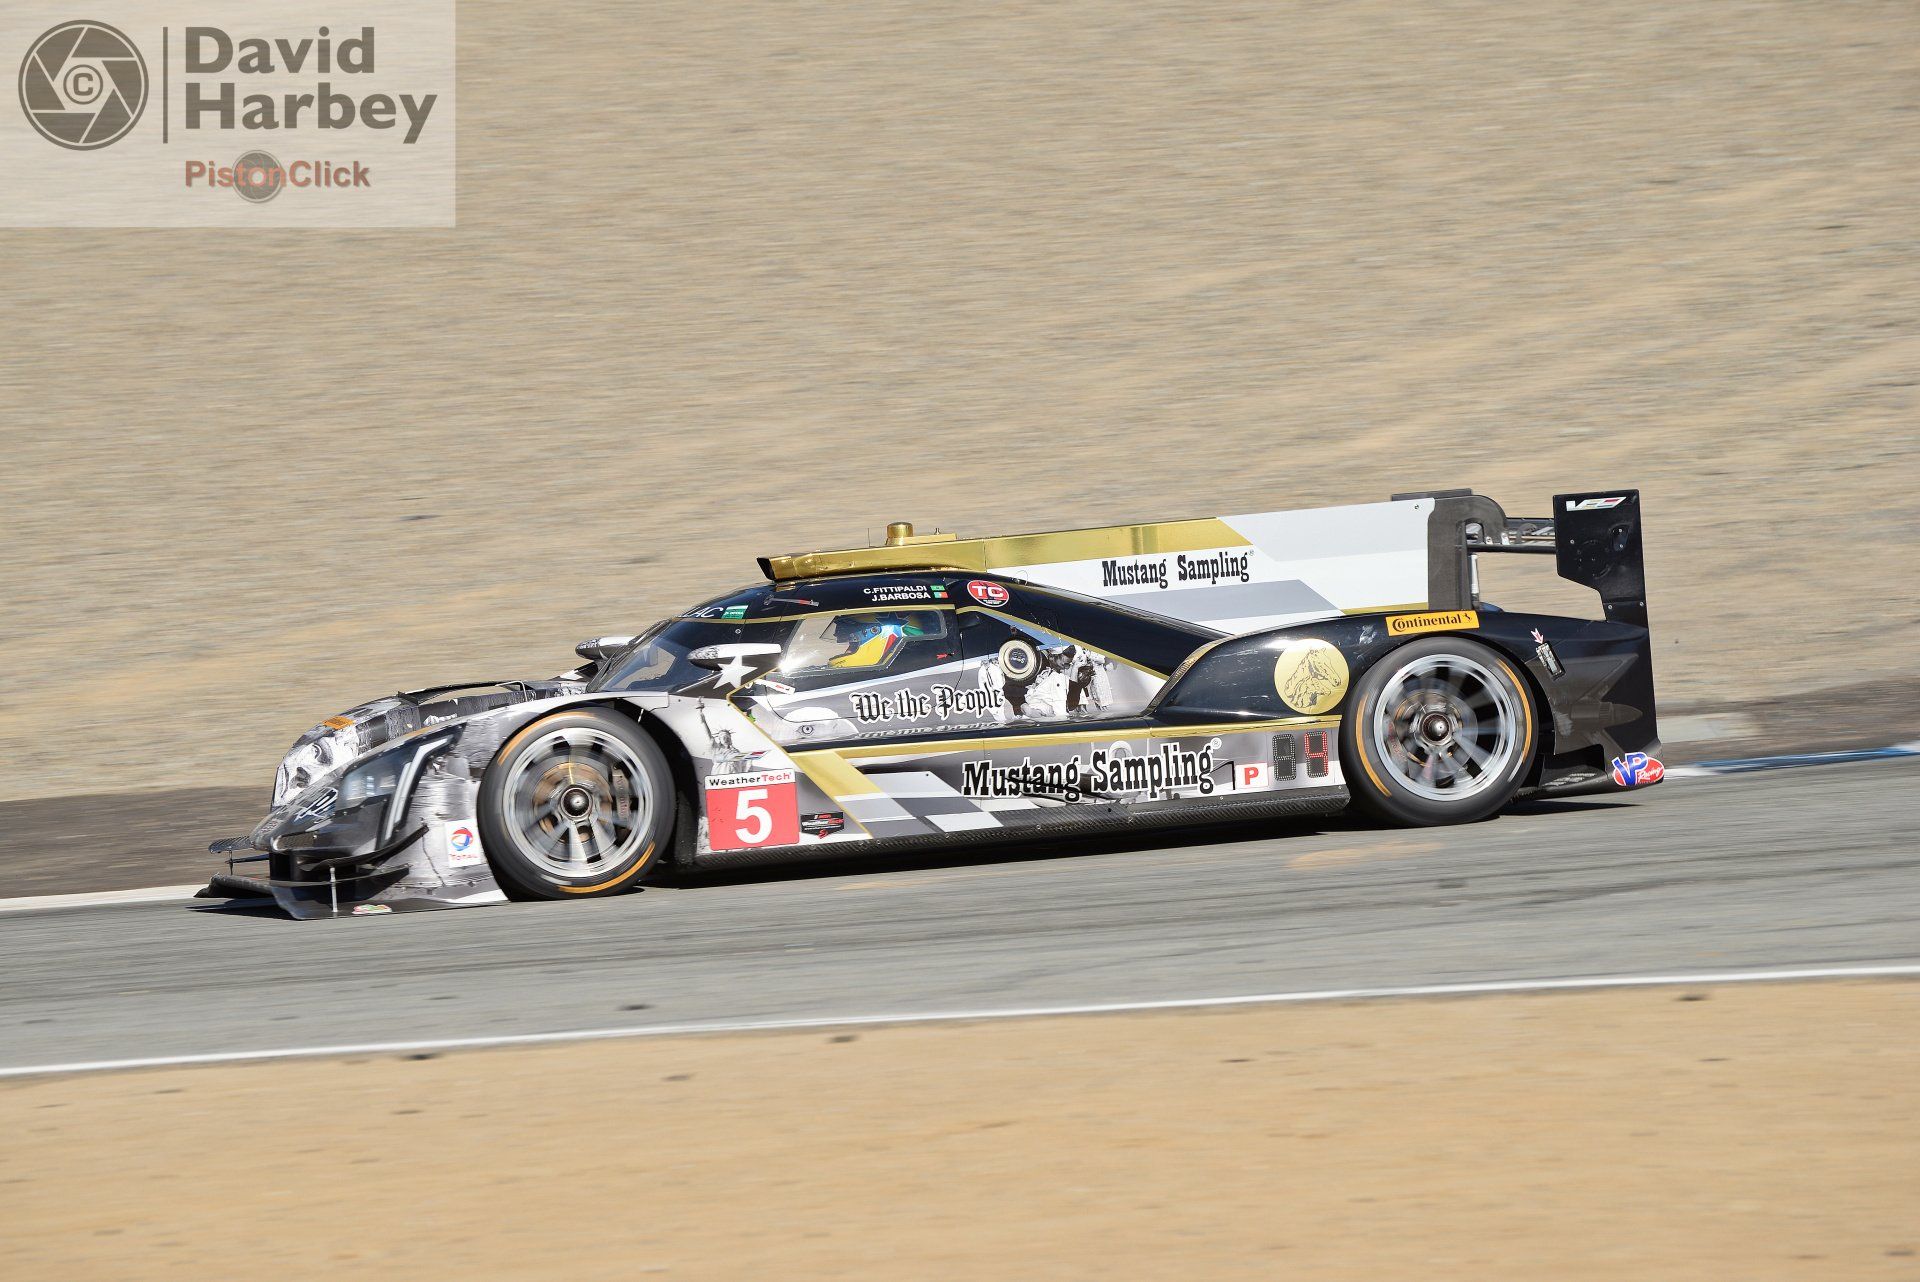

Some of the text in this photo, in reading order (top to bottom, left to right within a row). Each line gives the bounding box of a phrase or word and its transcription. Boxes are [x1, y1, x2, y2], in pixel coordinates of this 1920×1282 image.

[1101, 551, 1250, 590] Mustang Sampling
[863, 585, 927, 595] C.FITTIPALDI
[871, 592, 931, 602] J.BARBOSA
[971, 585, 1004, 598] TC
[1391, 613, 1462, 633] Continental
[851, 682, 1003, 723] We the People
[1243, 766, 1260, 786] P
[1612, 752, 1648, 786] VP
[708, 772, 791, 787] WeatherTech
[963, 757, 1082, 802] Mustang
[735, 788, 773, 844] 5
